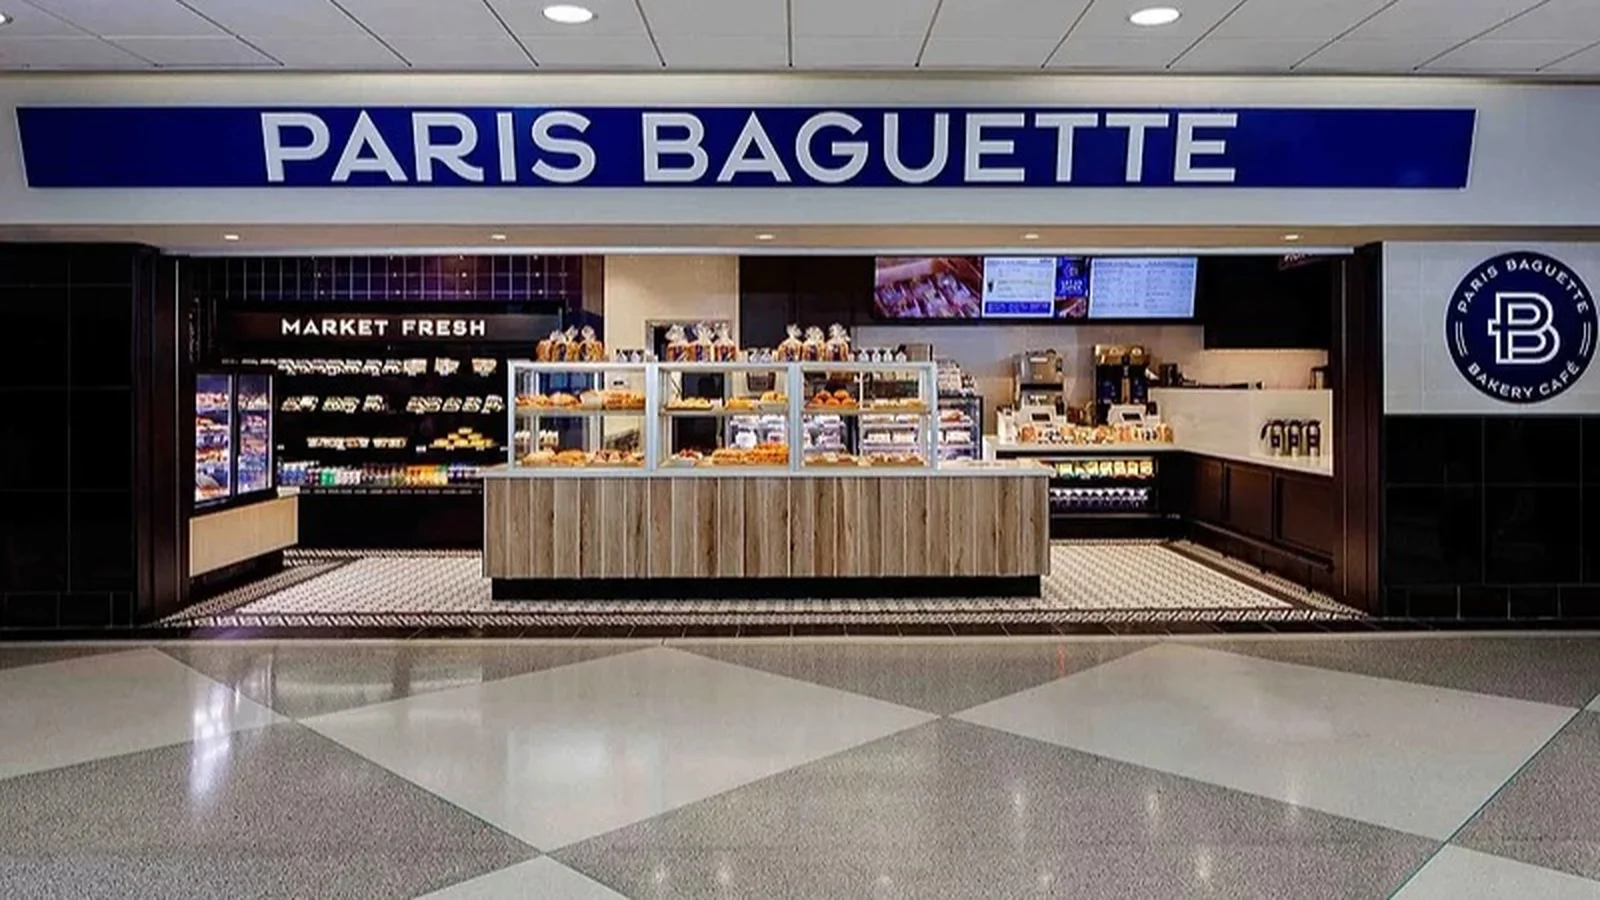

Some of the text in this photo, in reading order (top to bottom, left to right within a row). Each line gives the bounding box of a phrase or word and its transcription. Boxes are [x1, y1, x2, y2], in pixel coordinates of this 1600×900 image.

[261, 111, 1238, 183] PARIS BAGUETTE
[1457, 258, 1589, 314] PARIS BAGUETTE
[281, 318, 485, 336] MARKET FRESH
[1467, 360, 1580, 399] BAKERY CAFÉ
